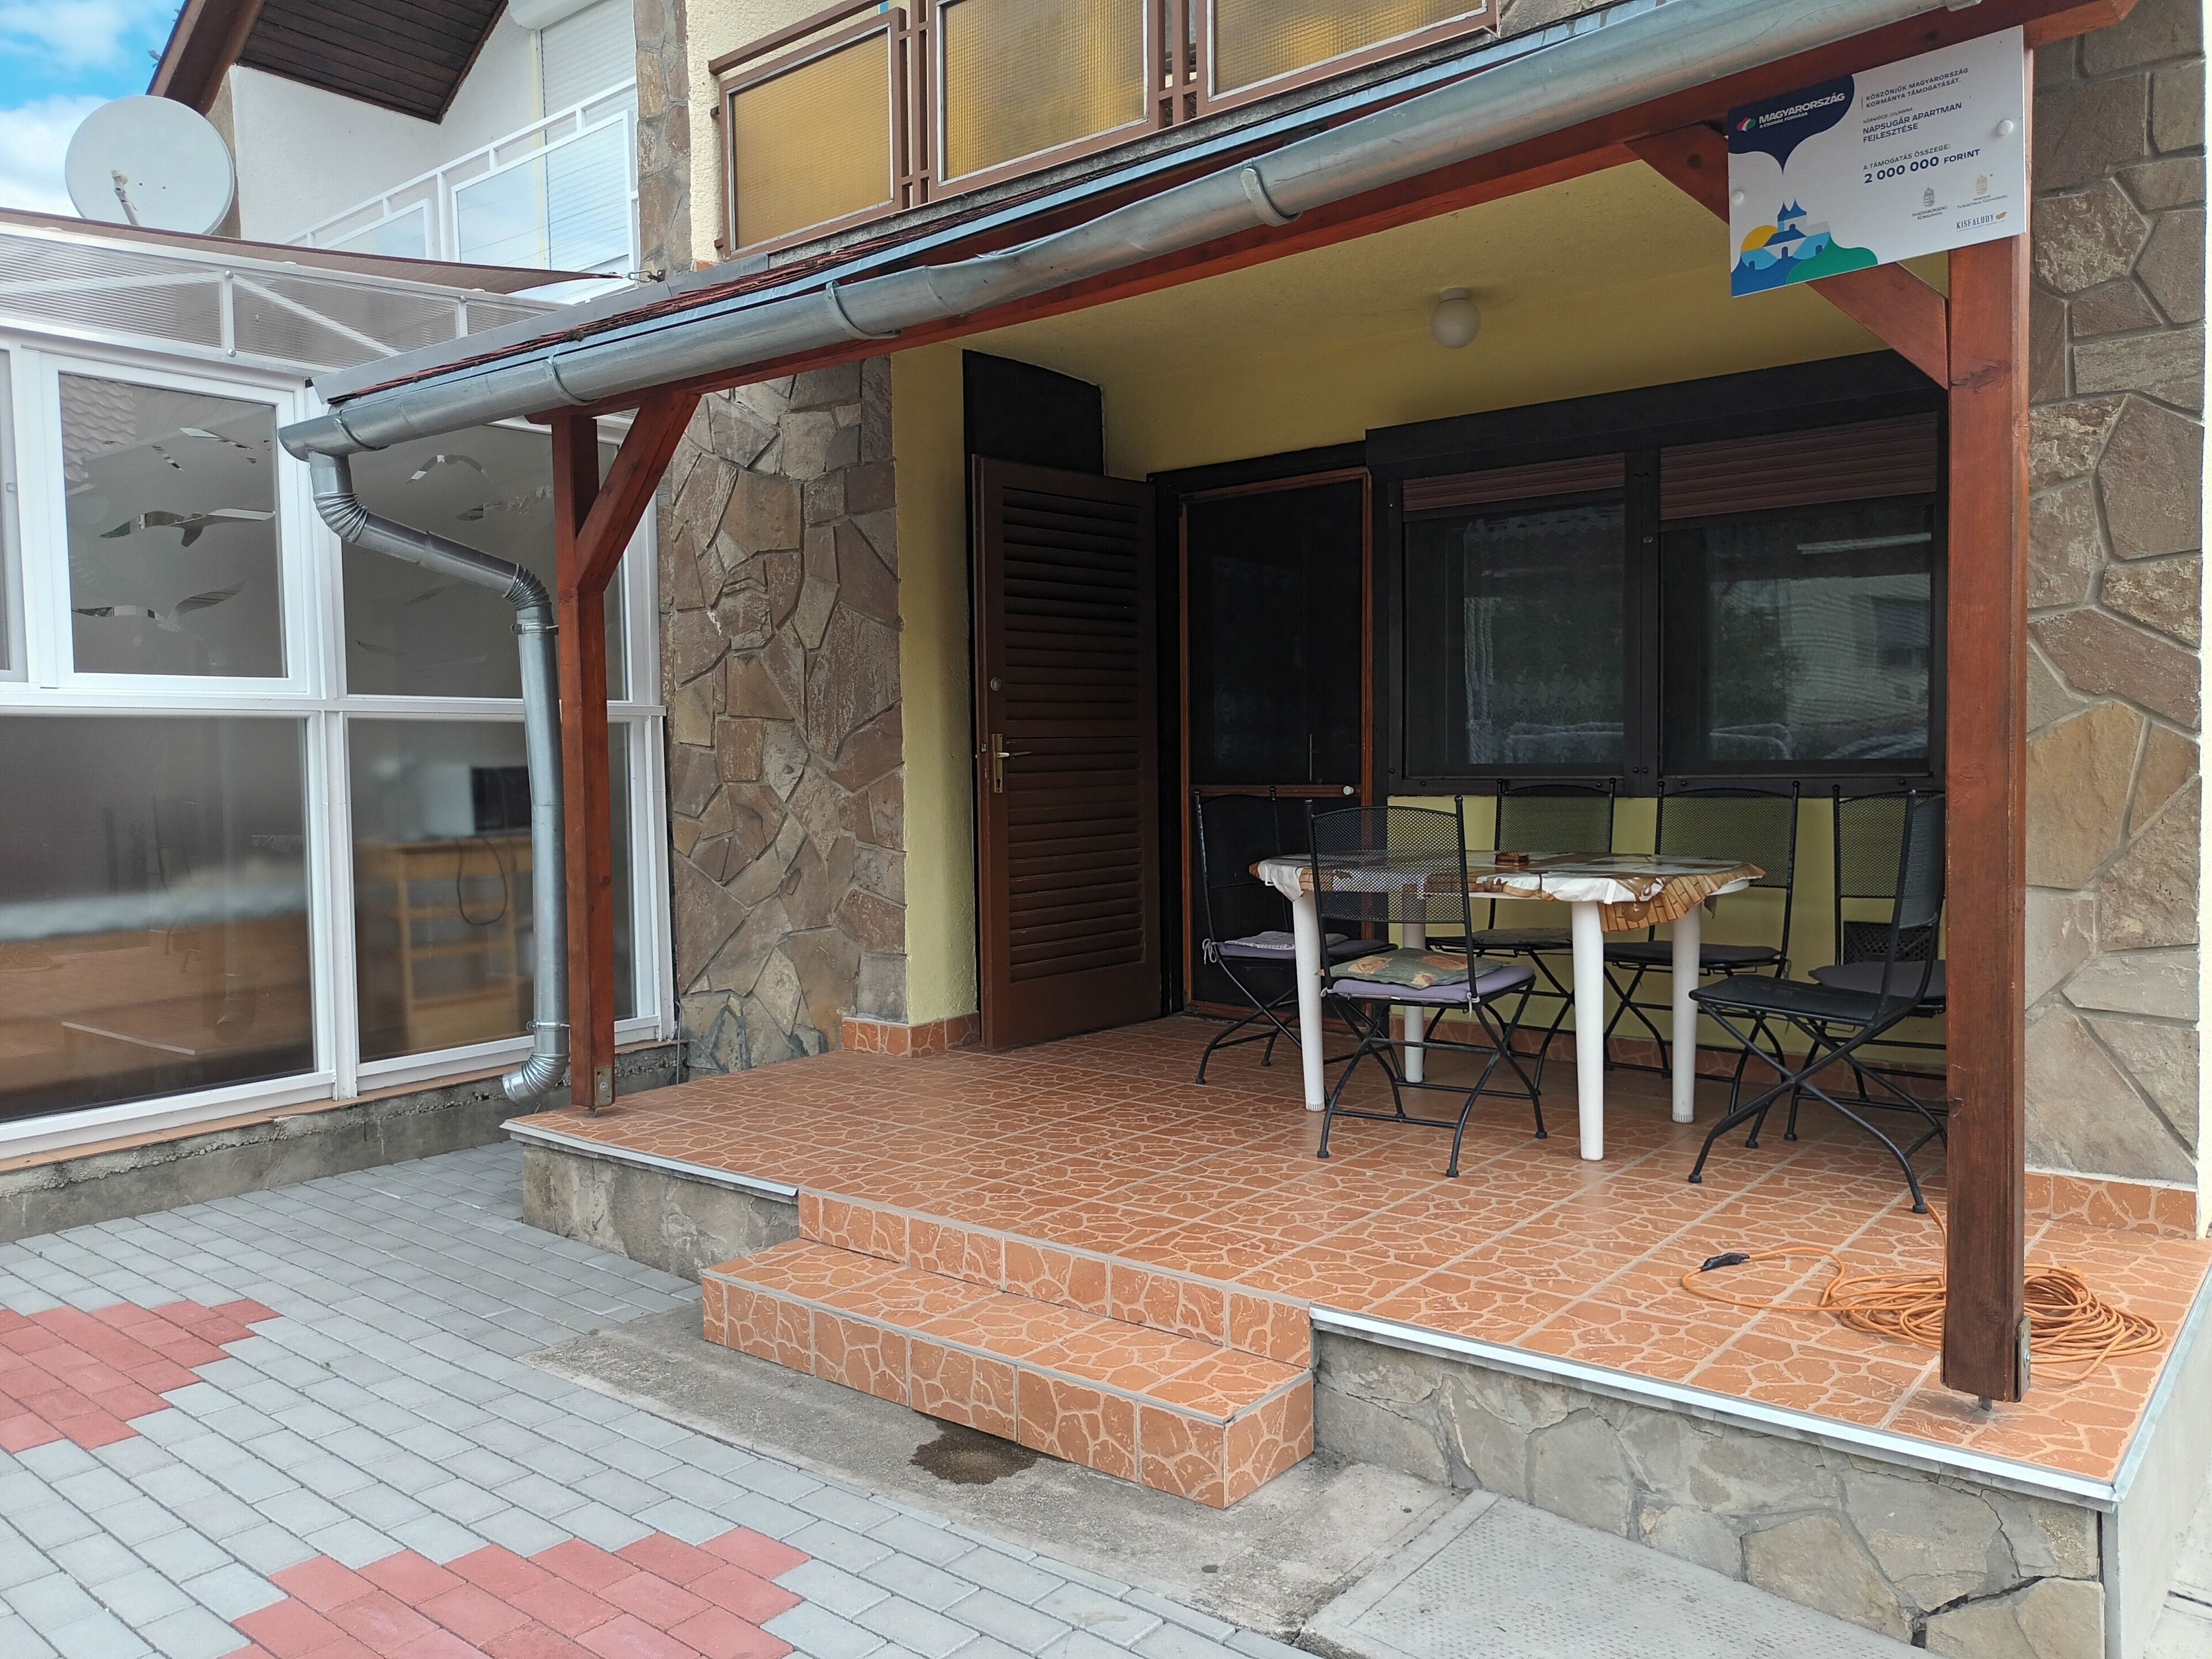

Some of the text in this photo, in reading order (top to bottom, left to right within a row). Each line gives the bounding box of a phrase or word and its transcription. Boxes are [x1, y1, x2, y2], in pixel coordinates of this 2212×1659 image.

[1866, 67, 1968, 101] KÖSZÖNJÜK MAGYARORSZÁG
[1866, 78, 1961, 108] KORMÁNYA TÁMOGATÁSÁT.
[1759, 92, 1845, 124] MAGYARORSZÁG
[1863, 102, 1962, 134] NAPSUGÁR APARTMAN
[1863, 123, 1919, 143] FEJLESZTÉSE
[1864, 149, 1980, 184] 2 000 000 FORINT
[1870, 153, 1912, 168] TÁMOGATÁS
[1914, 143, 1950, 157] ÖSSZEGE:
[1956, 214, 1995, 229] KISFALUDY
